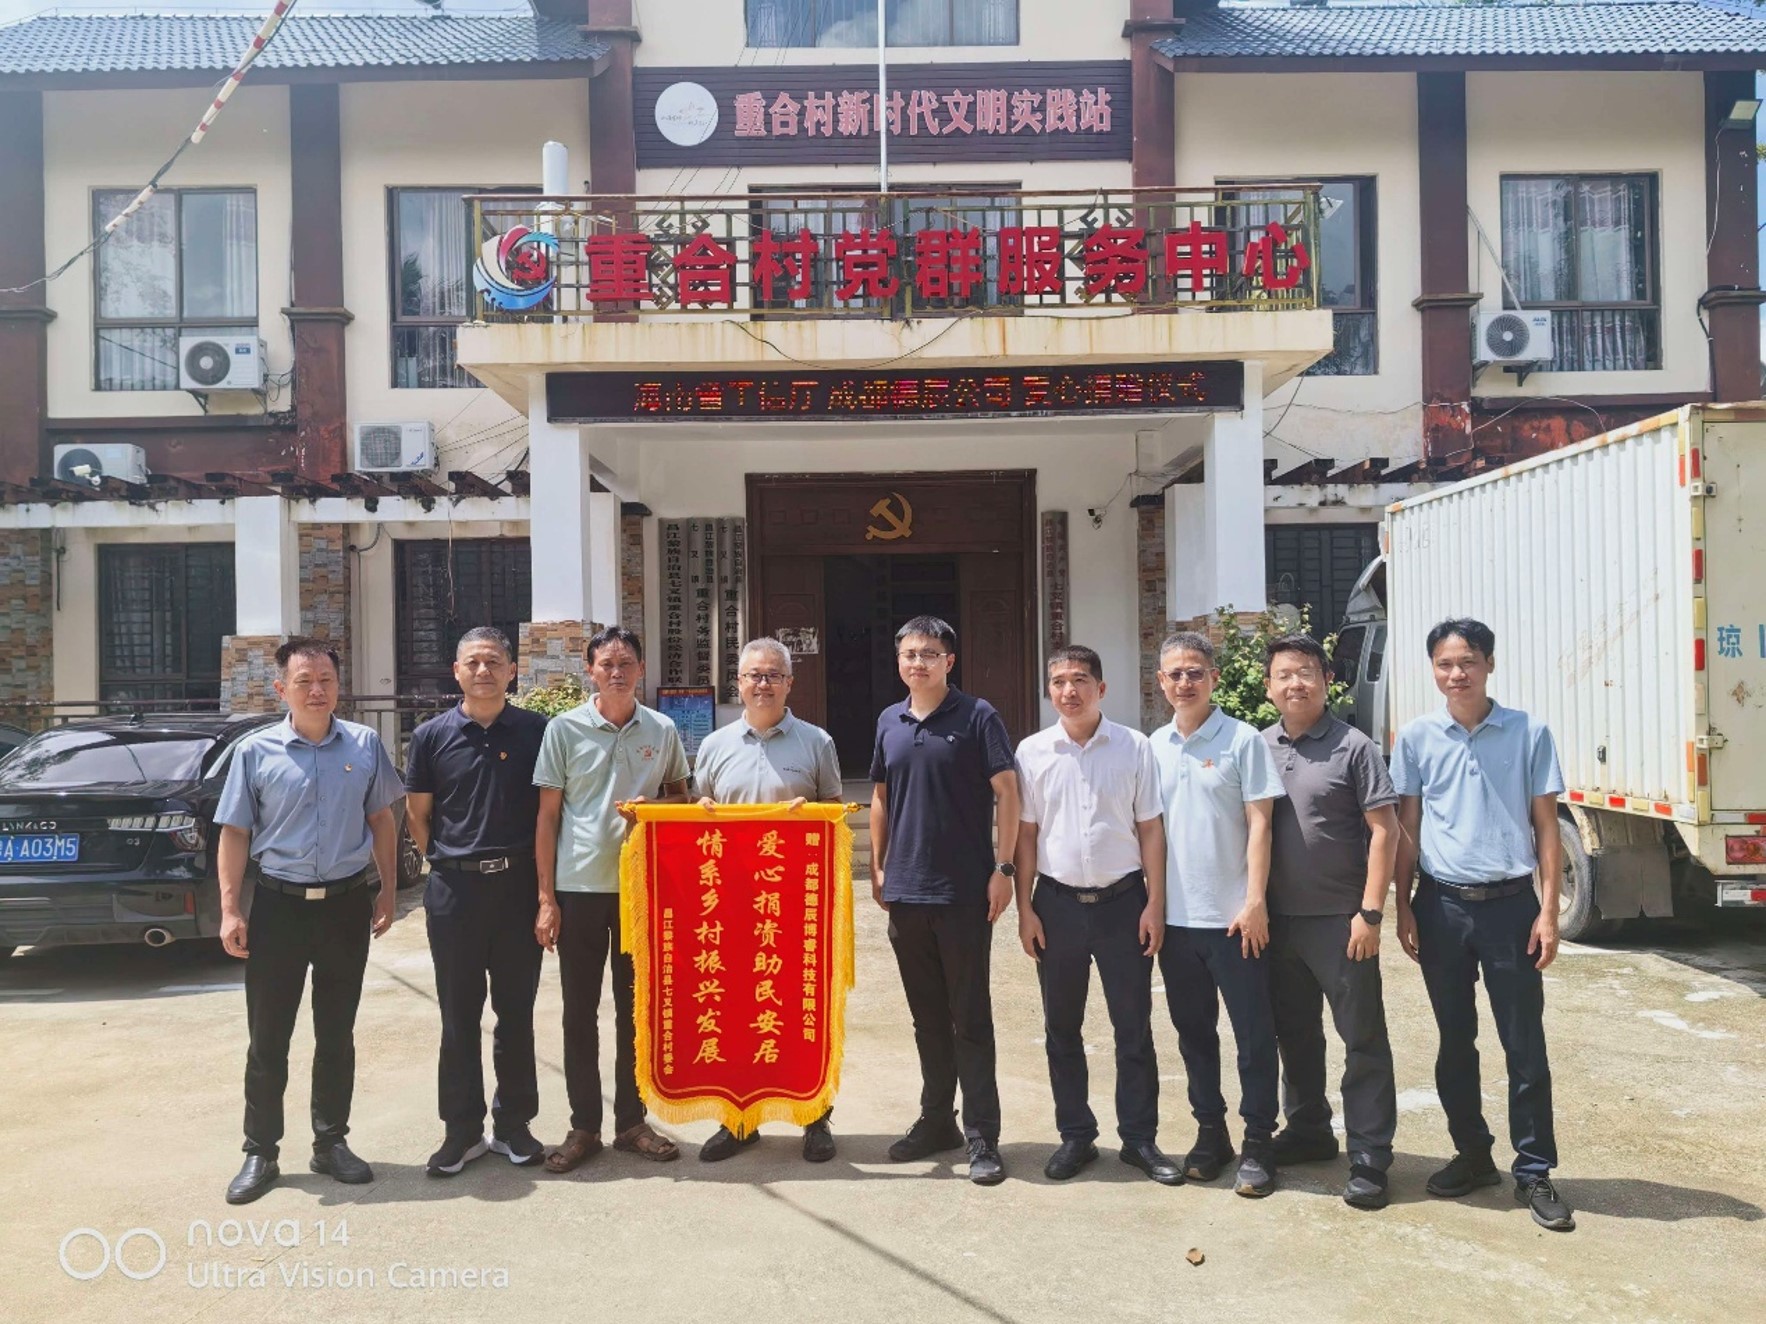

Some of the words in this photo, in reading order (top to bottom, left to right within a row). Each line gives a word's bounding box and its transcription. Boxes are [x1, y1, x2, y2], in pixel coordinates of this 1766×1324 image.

[734, 88, 1112, 137] 重合村新时代文明实践站
[584, 221, 1311, 306] 重合村党群服务中心
[724, 590, 740, 698] 重合村民委员会
[0, 837, 76, 858] A·A03M5
[691, 829, 727, 1064] 情系乡村振兴发展
[749, 829, 785, 1064] 爱心捐资助民安居
